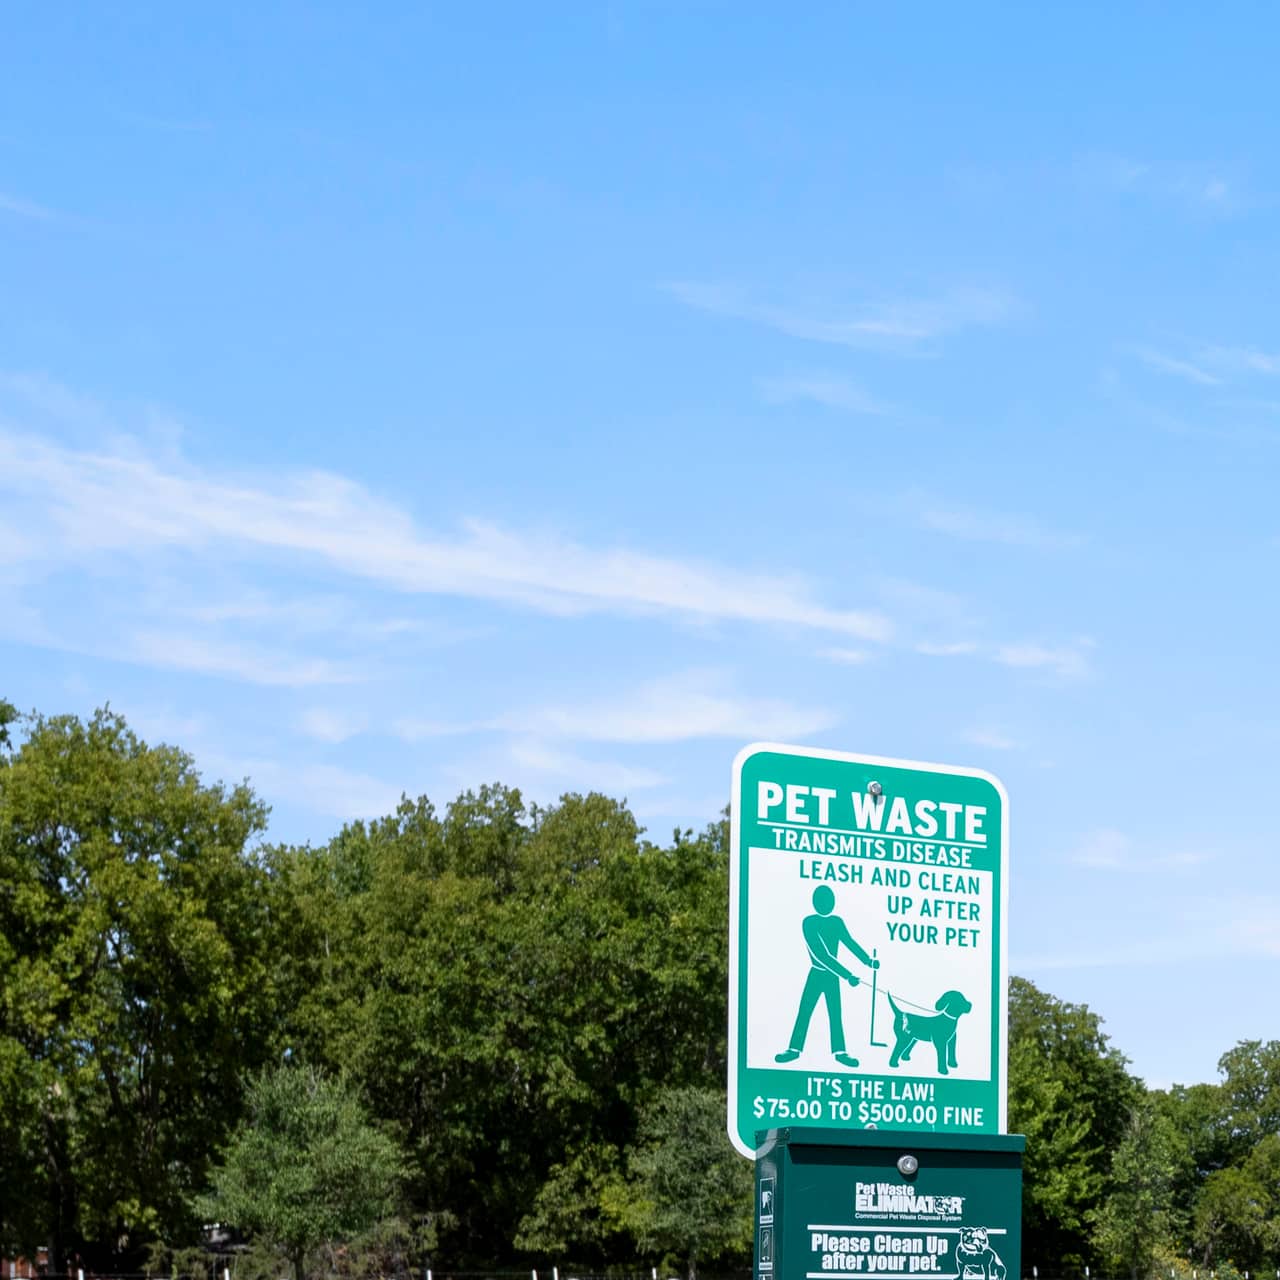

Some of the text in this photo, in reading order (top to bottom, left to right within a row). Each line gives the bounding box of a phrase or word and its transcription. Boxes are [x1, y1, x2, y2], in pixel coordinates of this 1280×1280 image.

[757, 781, 987, 842] PET WASTE
[772, 828, 972, 868] TRANSMITS DISEASE
[800, 860, 980, 895] LEASH AND CLEAN
[887, 895, 981, 921] UP AFTER
[886, 922, 981, 948] YOUR PET
[807, 1077, 935, 1101] IT'S THE LAW!
[753, 1096, 984, 1126] $75.00 TO $500.00 FINE
[855, 1182, 915, 1196] Pet Waste
[811, 1232, 949, 1256] Please Clean Up
[821, 1251, 942, 1273] after your pet.
